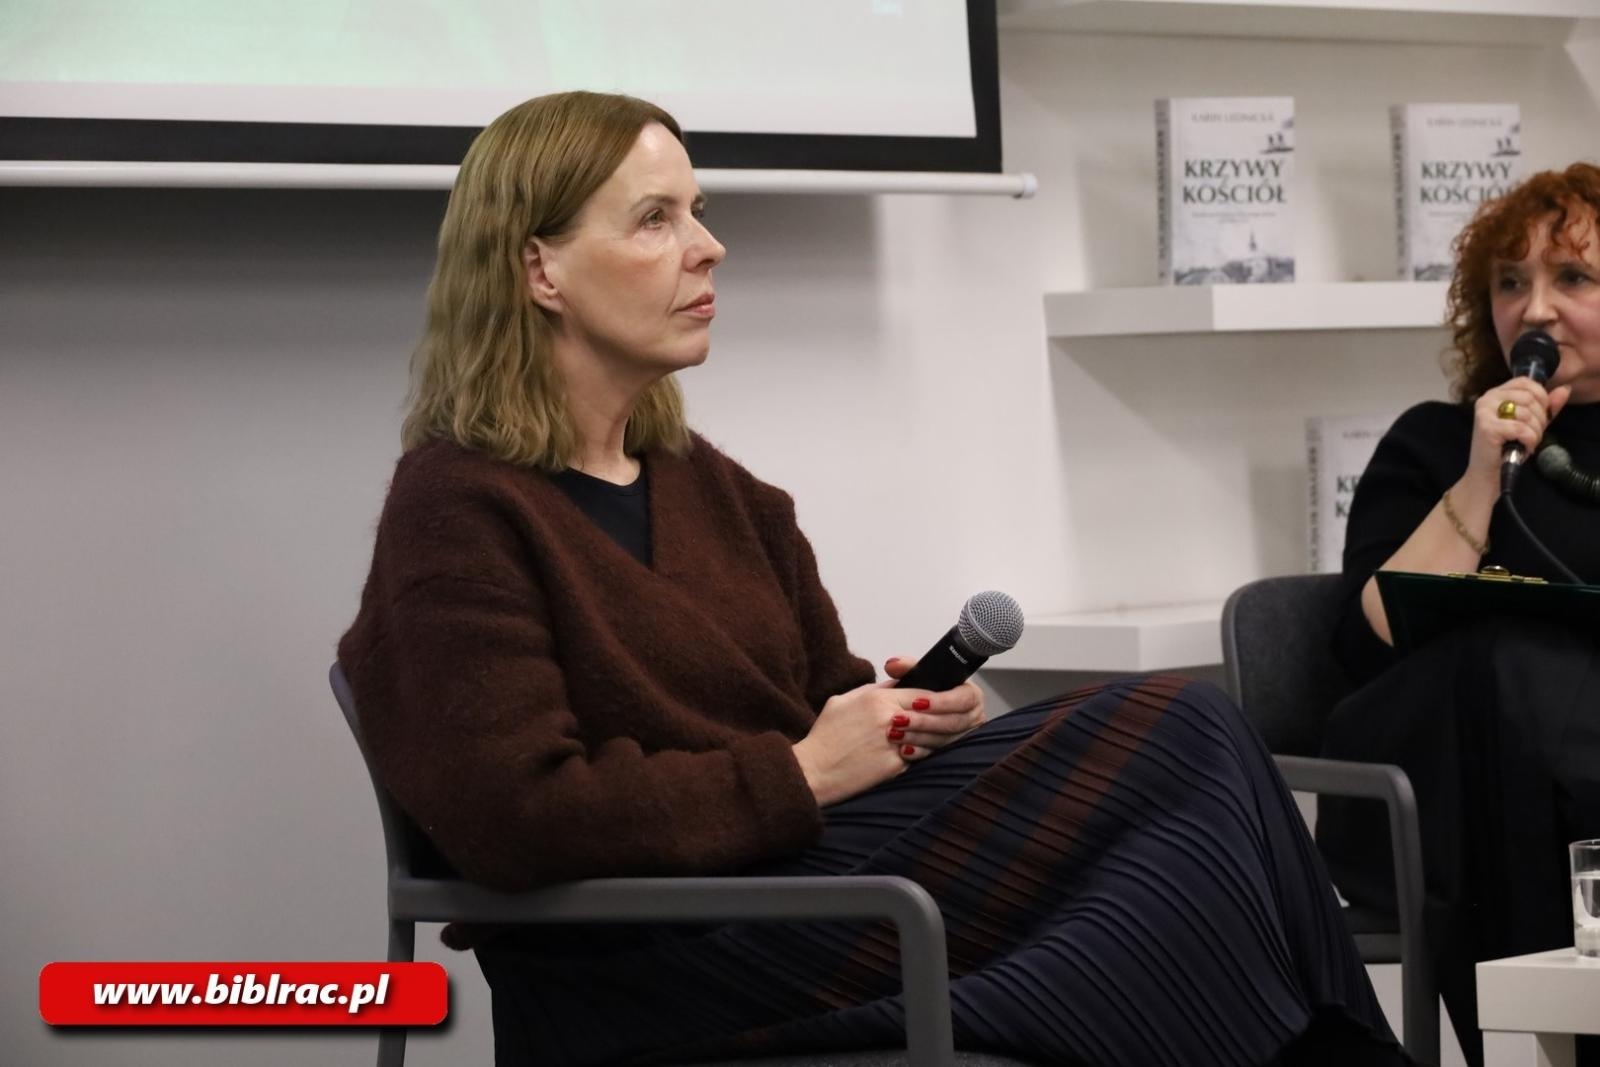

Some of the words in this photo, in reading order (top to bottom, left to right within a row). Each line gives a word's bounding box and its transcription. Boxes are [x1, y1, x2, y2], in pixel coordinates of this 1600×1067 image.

[1184, 159, 1284, 178] KRZYWY
[1421, 161, 1511, 179] KRZYWY
[1183, 178, 1287, 203] KOŚCIÓŁ
